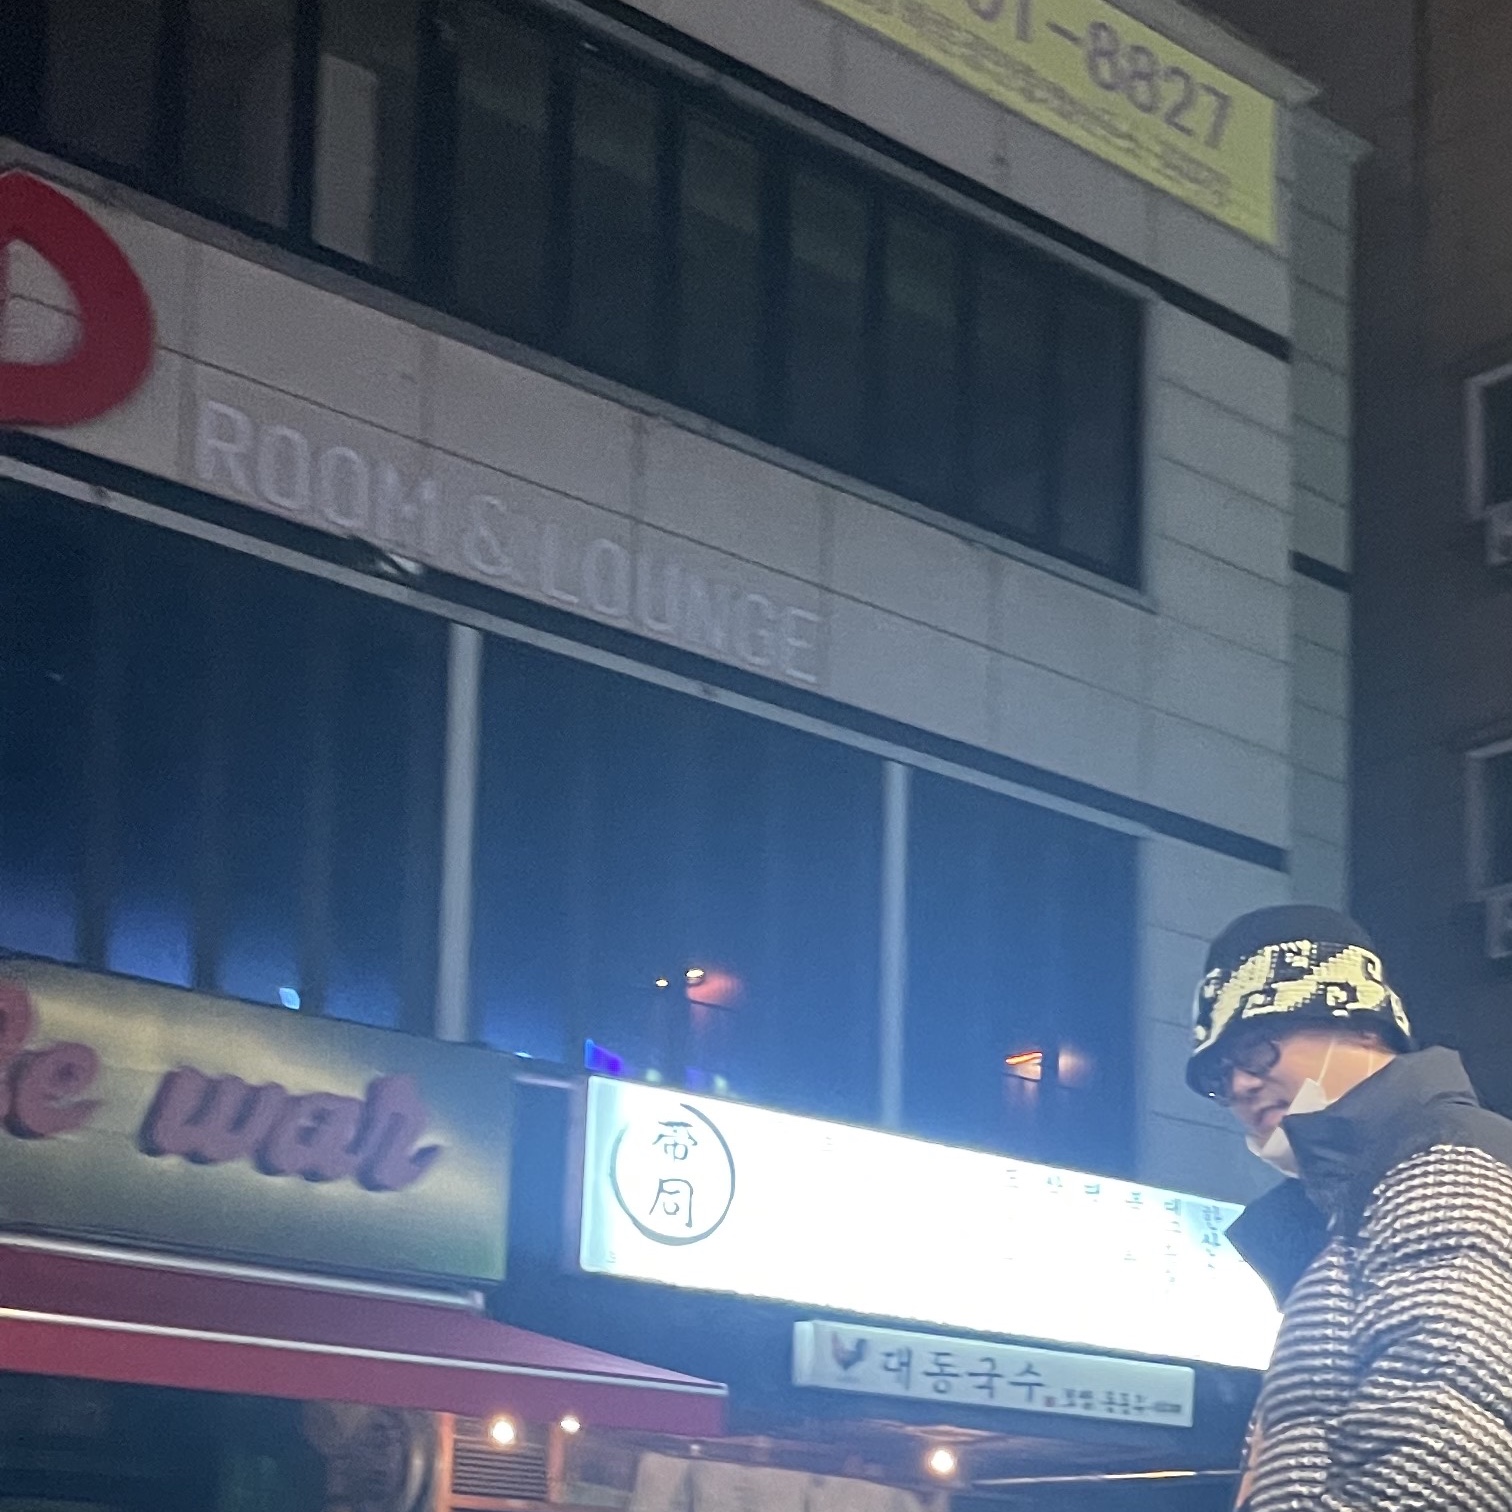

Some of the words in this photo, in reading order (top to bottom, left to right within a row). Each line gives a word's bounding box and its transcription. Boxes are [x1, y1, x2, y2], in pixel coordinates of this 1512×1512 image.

[195, 399, 440, 552] ROOM
[463, 494, 517, 578] &
[539, 522, 822, 685] LOUNGE
[880, 1345, 1046, 1405] 대동국수
